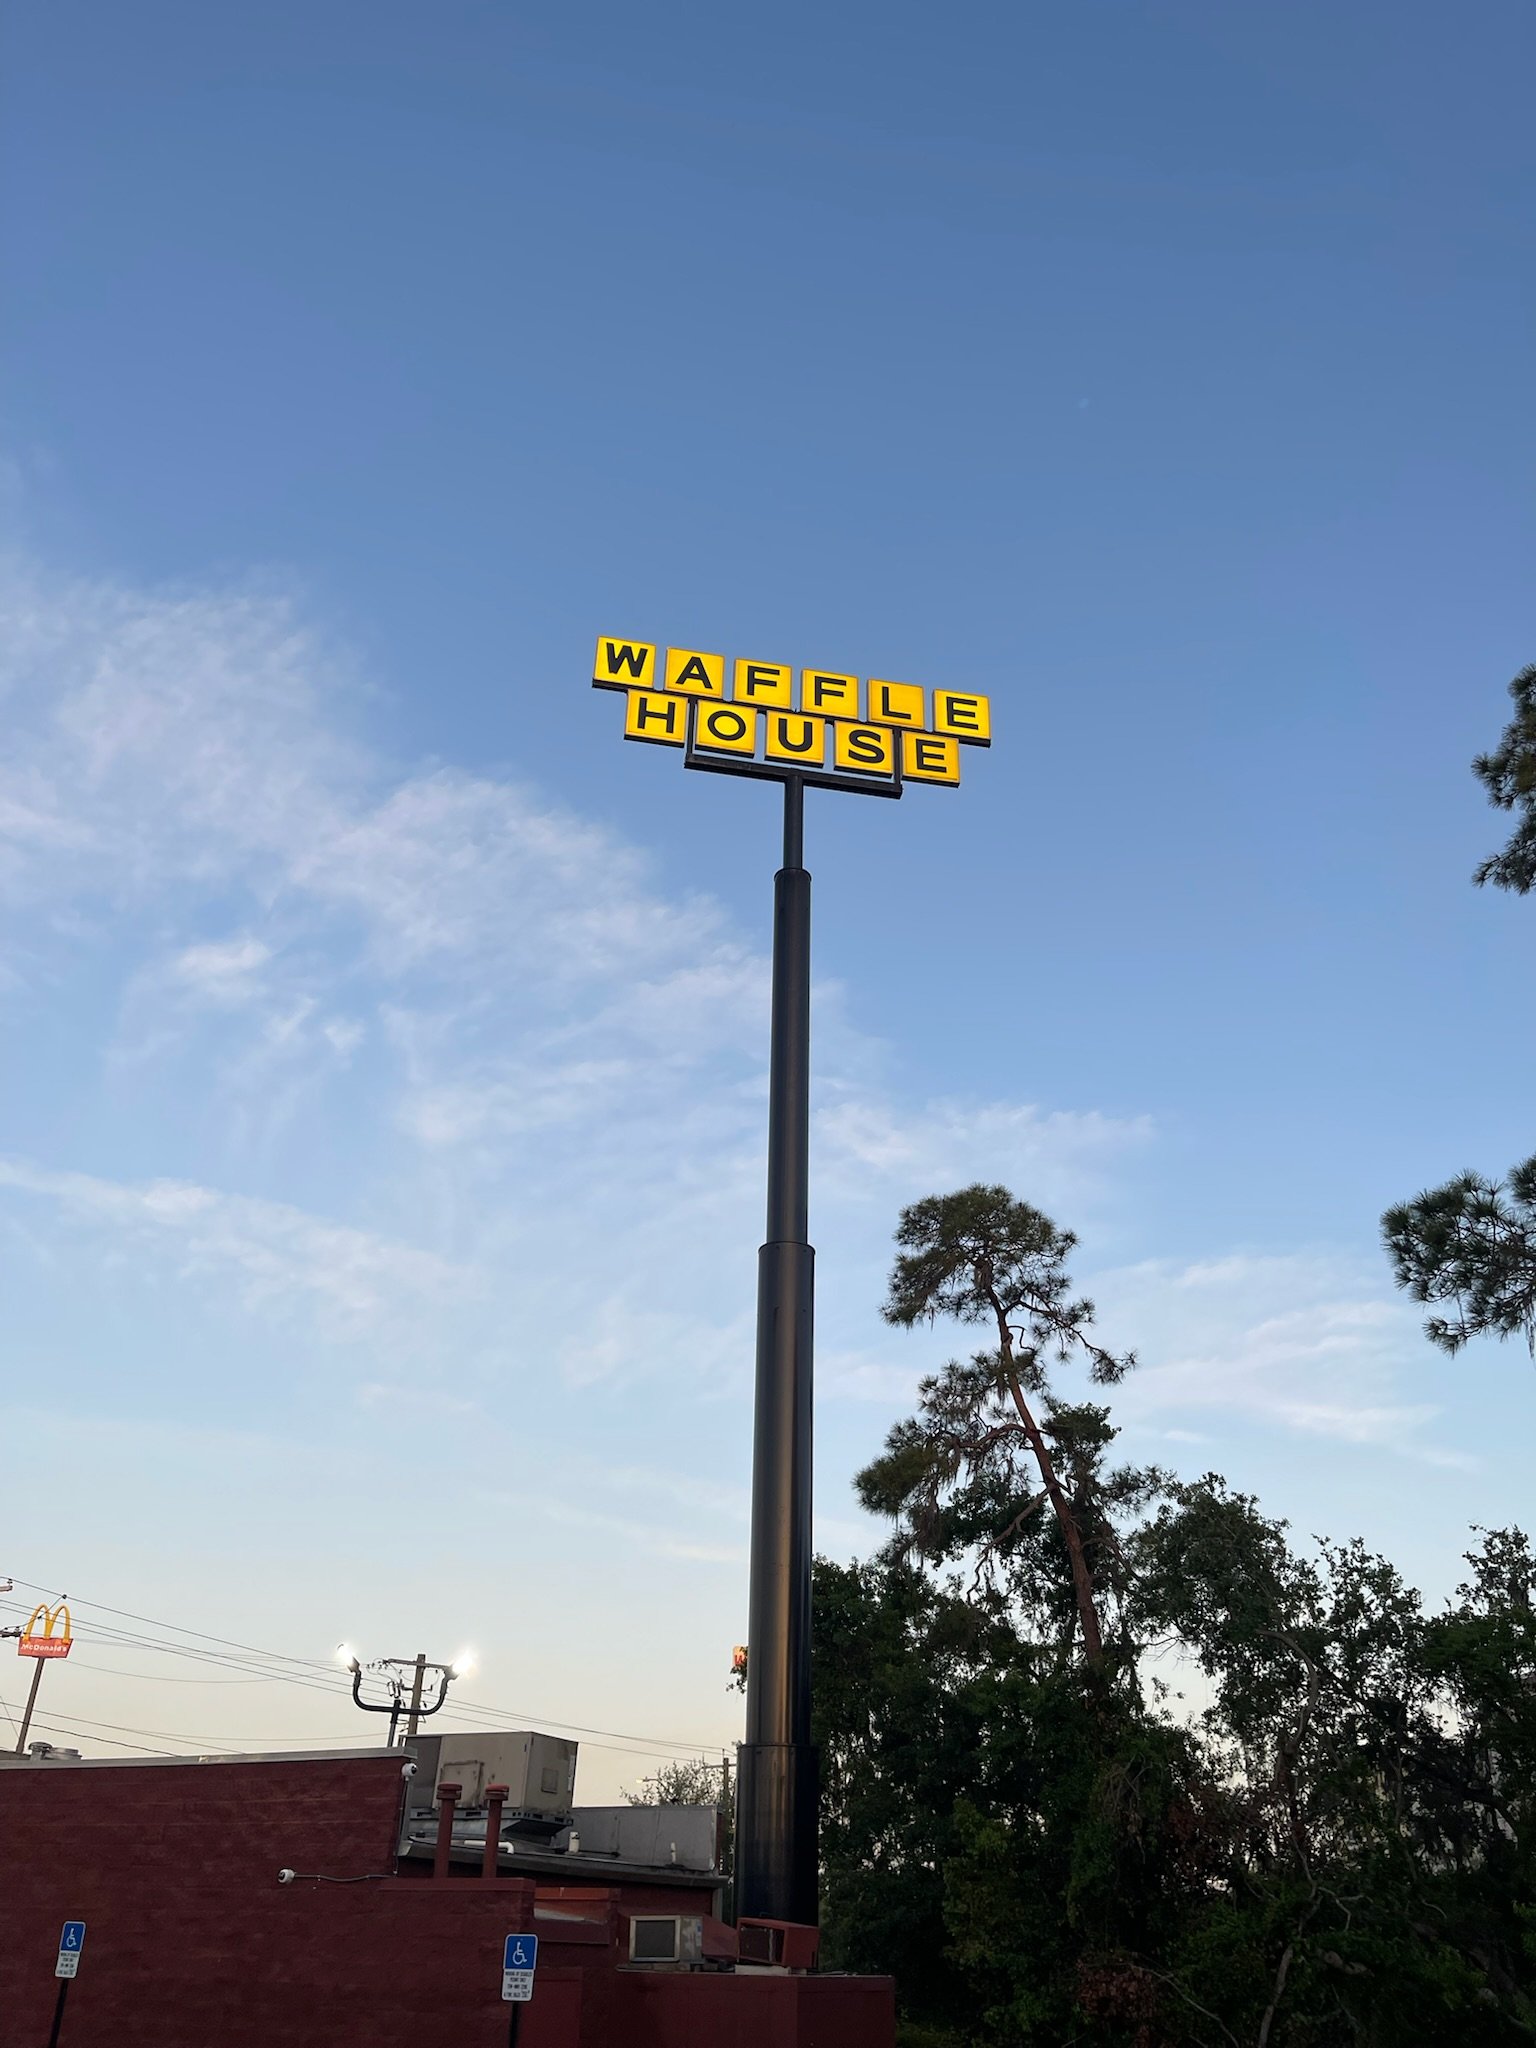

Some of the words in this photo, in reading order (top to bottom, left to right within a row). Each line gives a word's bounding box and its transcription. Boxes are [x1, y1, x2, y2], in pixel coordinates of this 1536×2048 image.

[606, 642, 979, 730] WAFFLE
[637, 697, 947, 773] HOUSE
[21, 1644, 67, 1652] McDonald's
